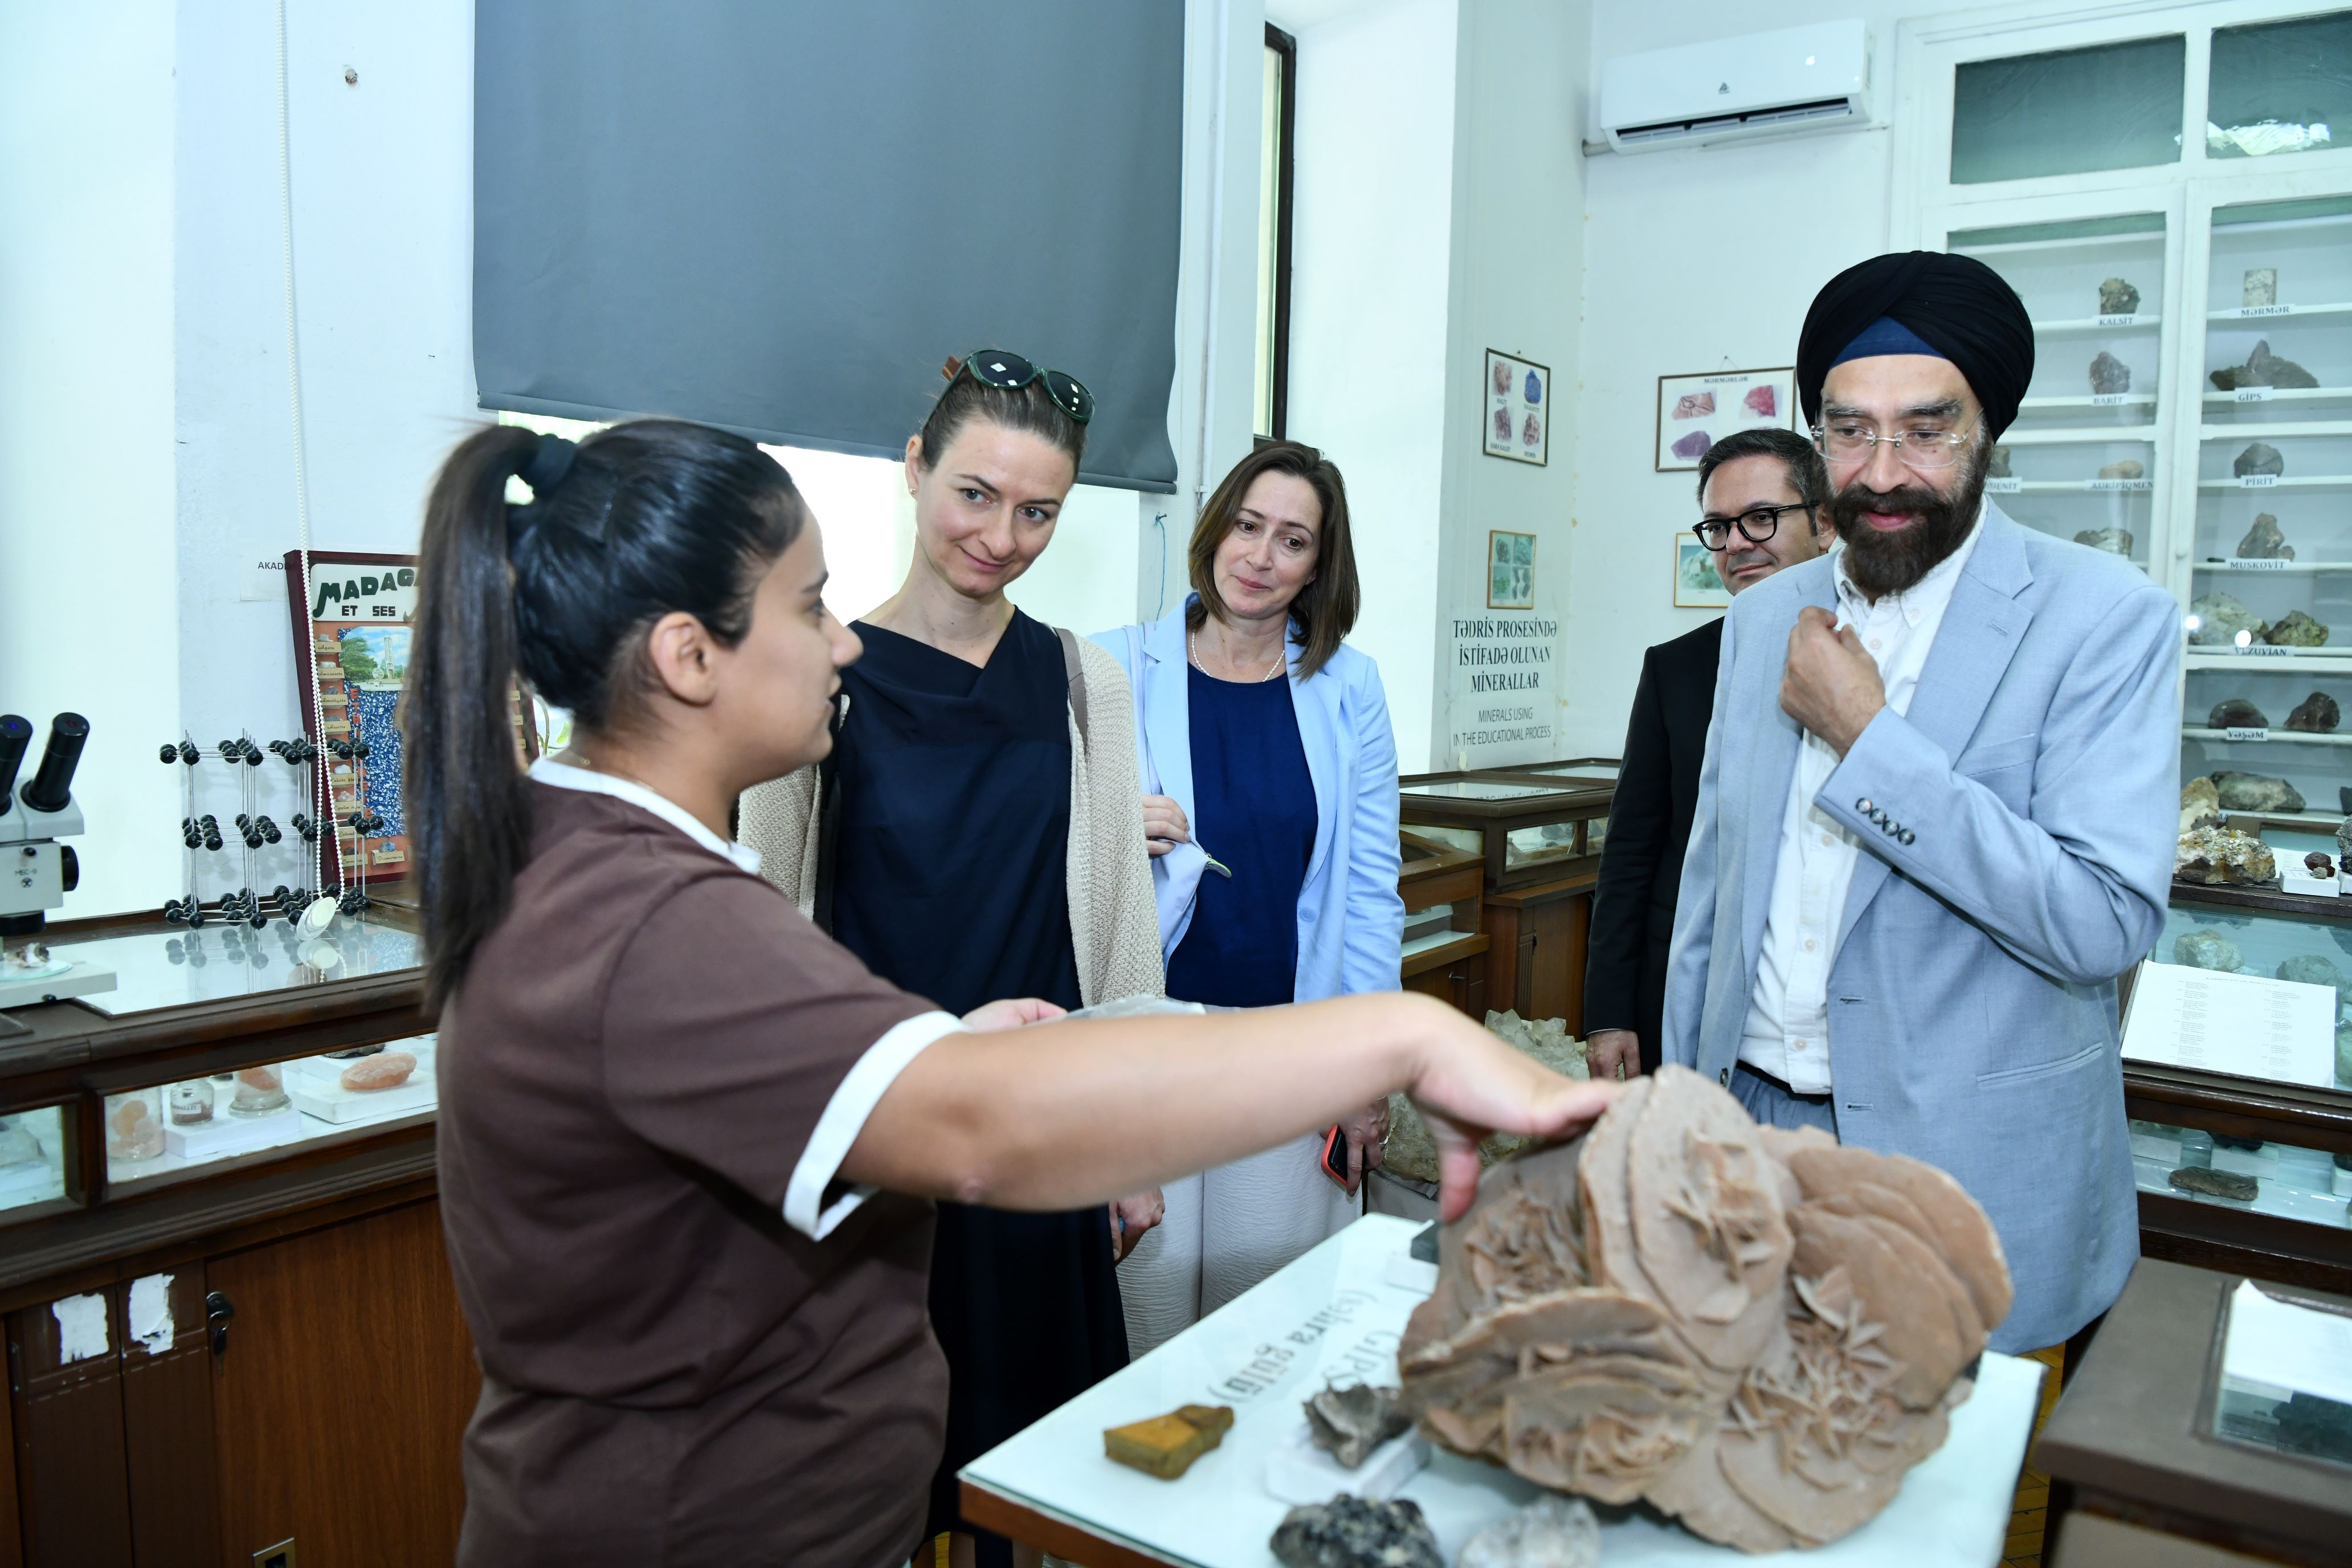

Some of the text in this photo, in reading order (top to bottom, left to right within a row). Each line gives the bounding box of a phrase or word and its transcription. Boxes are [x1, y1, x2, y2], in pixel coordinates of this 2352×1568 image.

[2241, 306, 2289, 317] MƏRMƏR
[2099, 317, 2134, 326] KALSİT
[2239, 392, 2262, 401] GİPS
[2246, 477, 2275, 486] PİRİT
[2230, 560, 2285, 569] MUSKOVİT
[342, 605, 358, 616] ET
[373, 606, 396, 616] SES
[1453, 616, 1557, 638] TƏDRİS PROSESİNDƏ
[1459, 644, 1551, 665] İSTİFADƏ OLUNAN
[1471, 671, 1540, 693] MİNERALLAR
[1478, 707, 1533, 722] MINERALS USING
[1462, 732, 1476, 746] THE
[1477, 728, 1524, 745] EDUCATIONAL
[1525, 725, 1551, 740] PROCESS
[2228, 731, 2264, 740] YƏŞƏM
